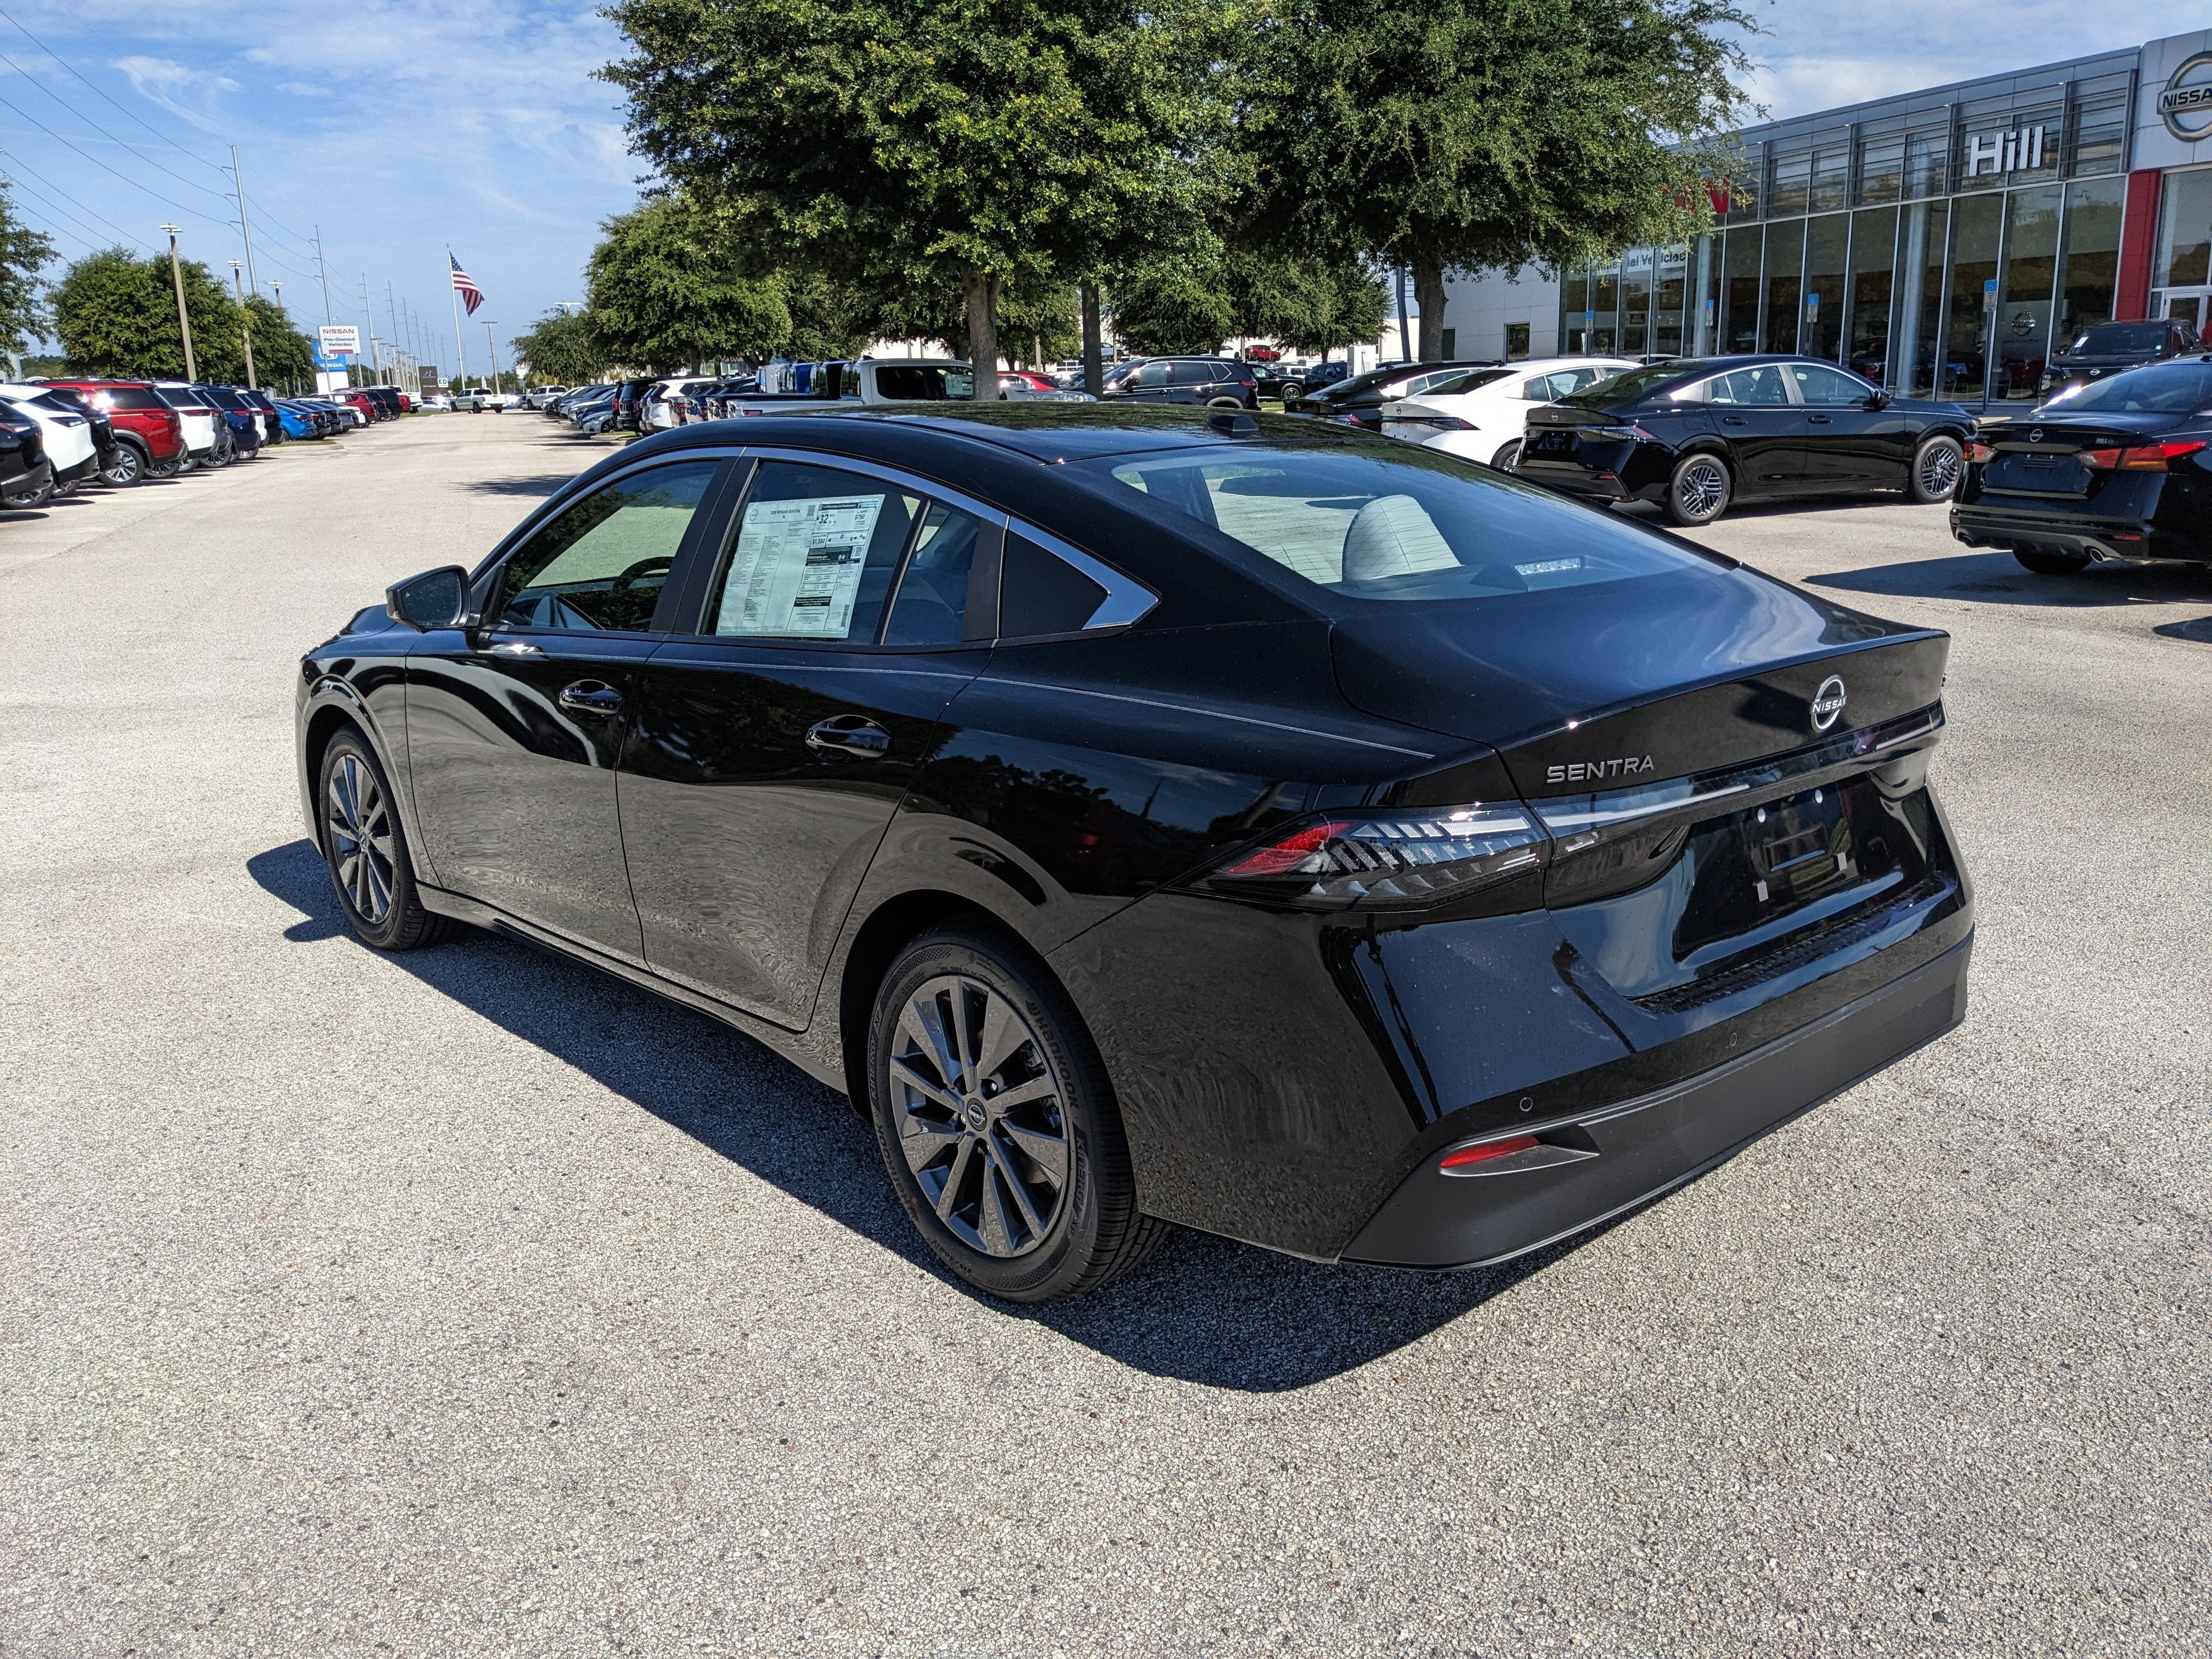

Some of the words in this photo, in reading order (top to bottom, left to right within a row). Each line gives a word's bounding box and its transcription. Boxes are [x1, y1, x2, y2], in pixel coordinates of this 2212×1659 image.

[2163, 88, 2212, 108] NISSA
[1968, 126, 2045, 177] Hill
[819, 514, 829, 524] 32
[1812, 697, 1846, 713] NISSAN
[1546, 755, 1654, 783] SENTRA
